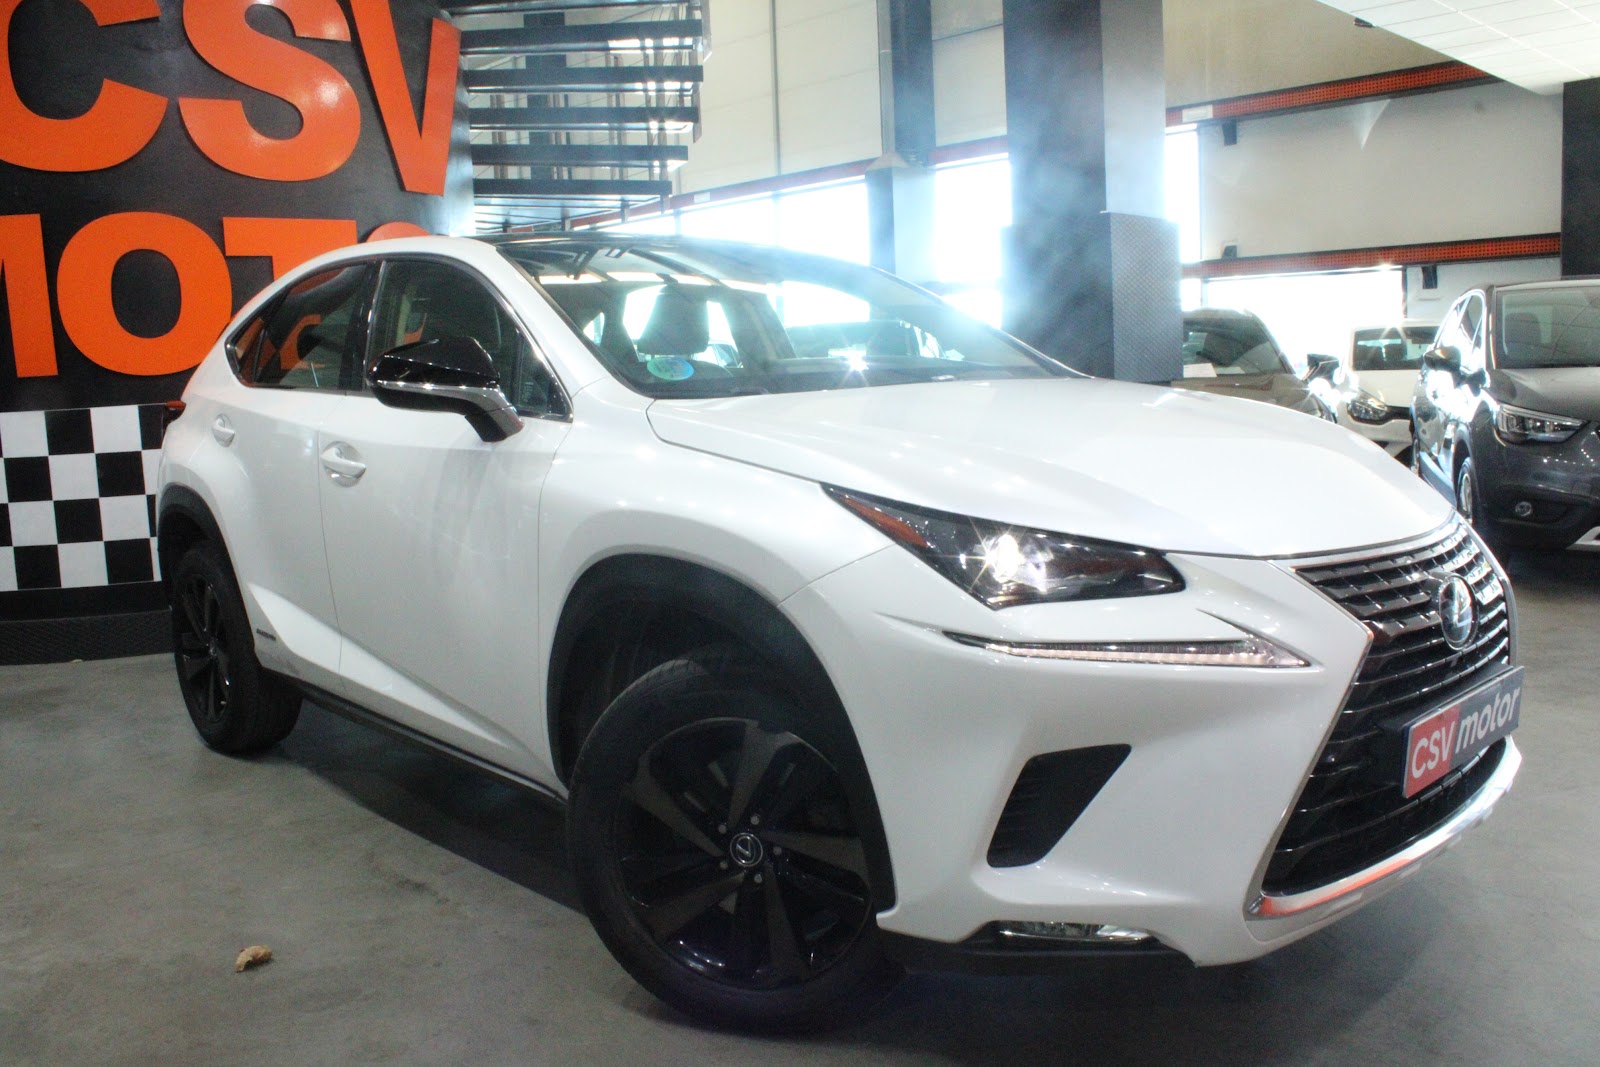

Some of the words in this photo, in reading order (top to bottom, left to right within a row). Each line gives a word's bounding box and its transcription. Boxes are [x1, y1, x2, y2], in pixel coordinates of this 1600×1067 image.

[0, 0, 461, 196] CSV
[1411, 721, 1455, 779] CSV
[1455, 687, 1521, 754] motor
